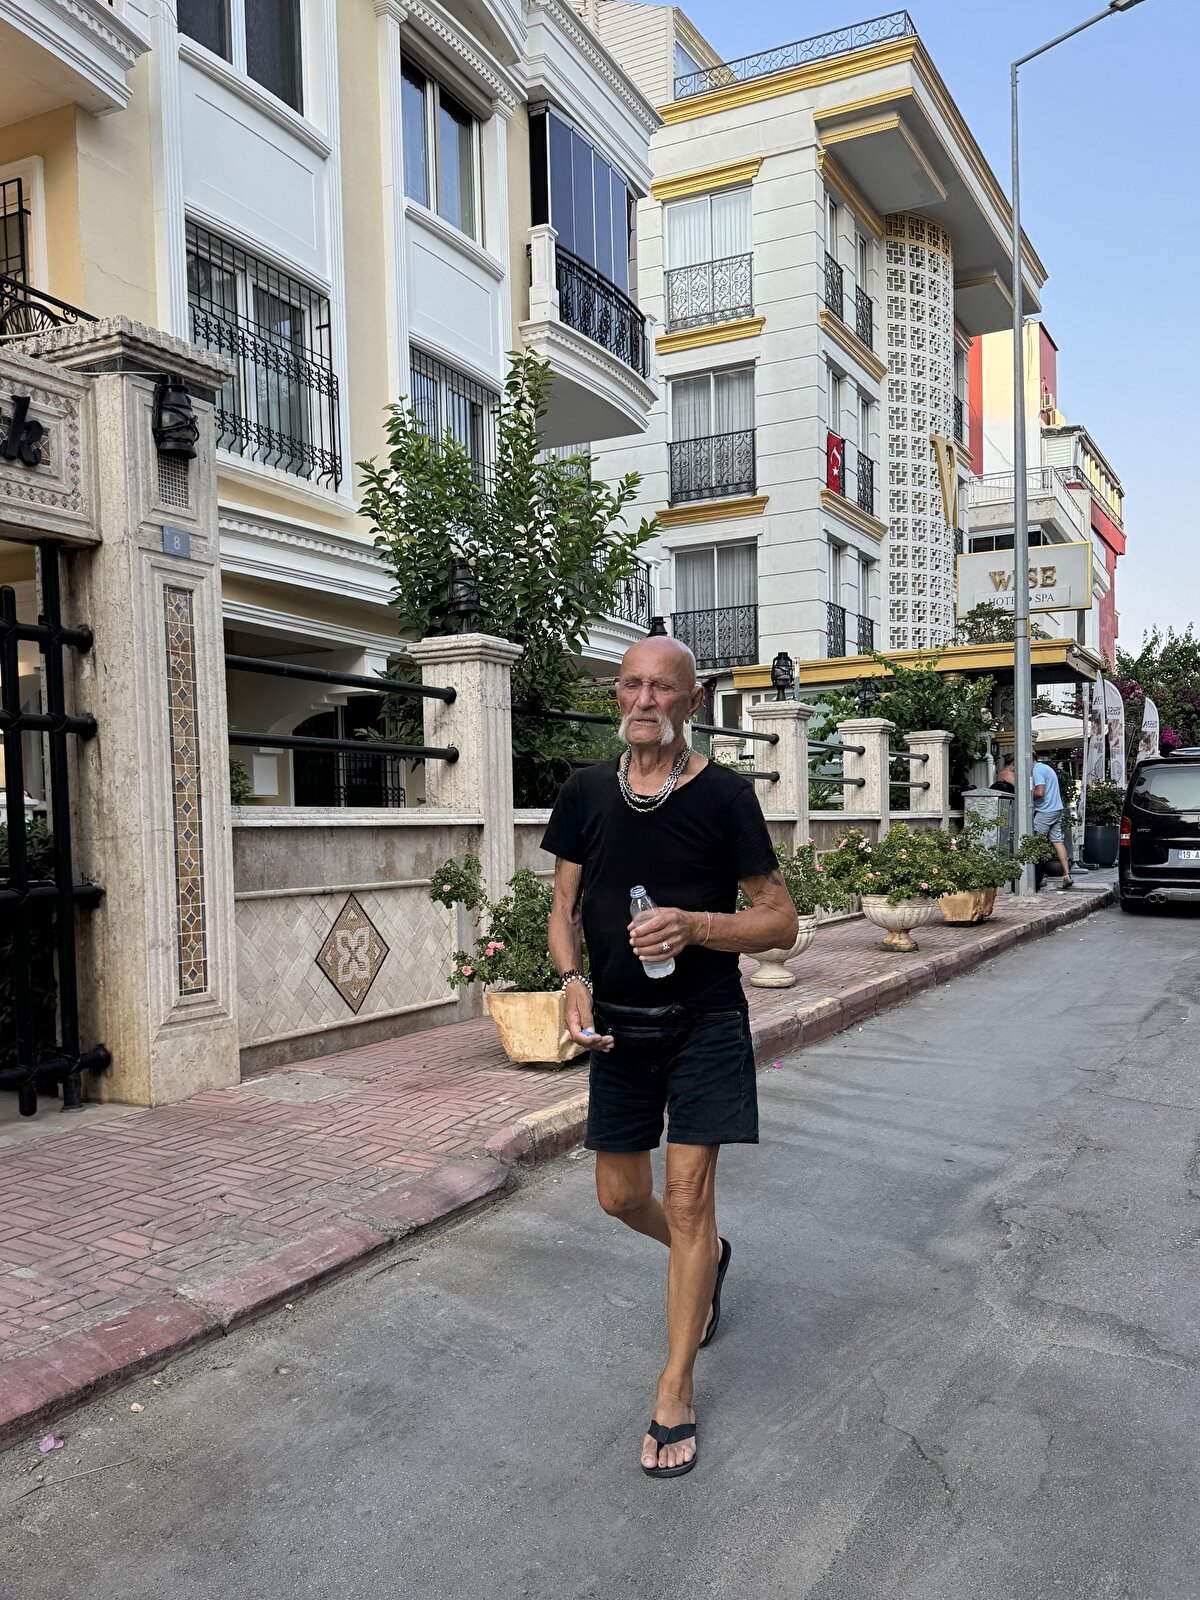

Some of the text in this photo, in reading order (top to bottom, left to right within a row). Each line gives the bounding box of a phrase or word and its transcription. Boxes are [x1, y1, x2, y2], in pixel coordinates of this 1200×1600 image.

[173, 535, 181, 550] 8
[988, 565, 1057, 592] WSE
[1034, 593, 1055, 603] SPA
[1182, 851, 1191, 859] 19
